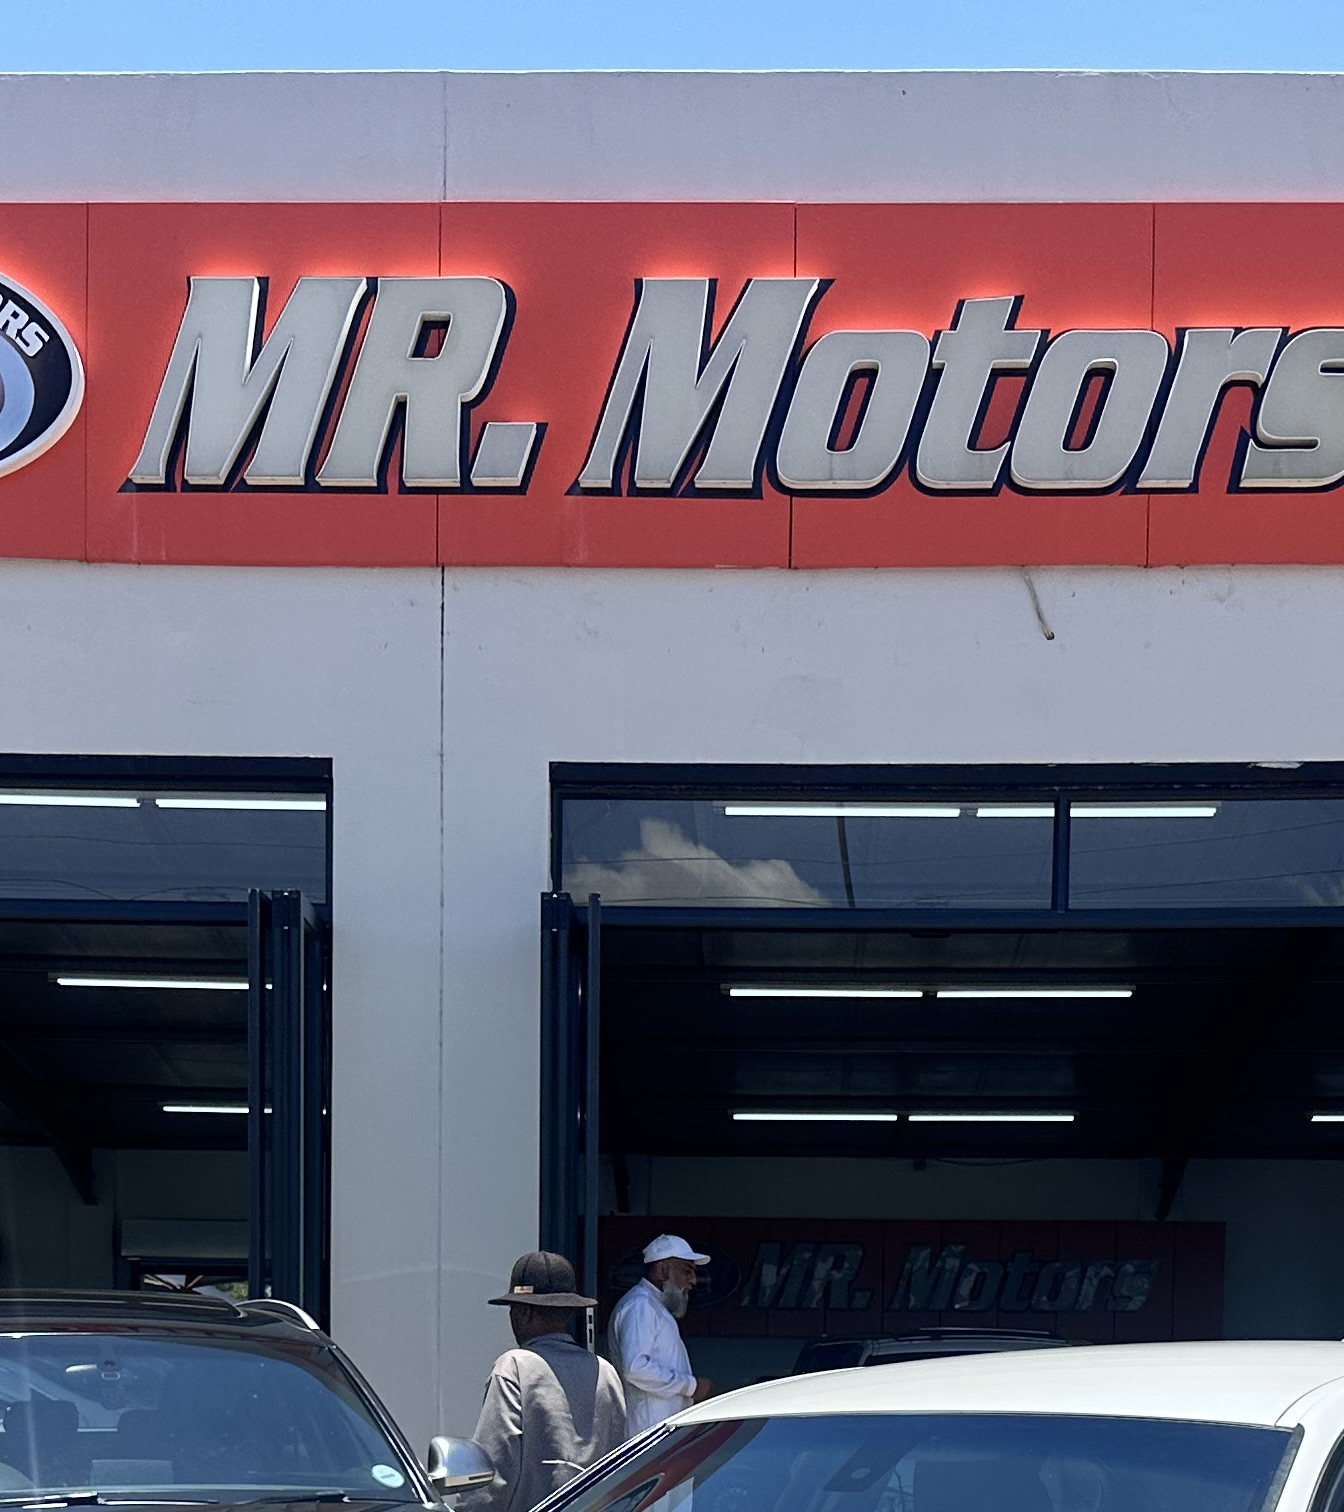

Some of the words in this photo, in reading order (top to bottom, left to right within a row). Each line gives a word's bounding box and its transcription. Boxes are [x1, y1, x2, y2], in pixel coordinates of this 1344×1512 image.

[122, 275, 546, 493] MR.
[740, 1241, 874, 1311] MR.
[886, 1243, 1158, 1312] Motors
